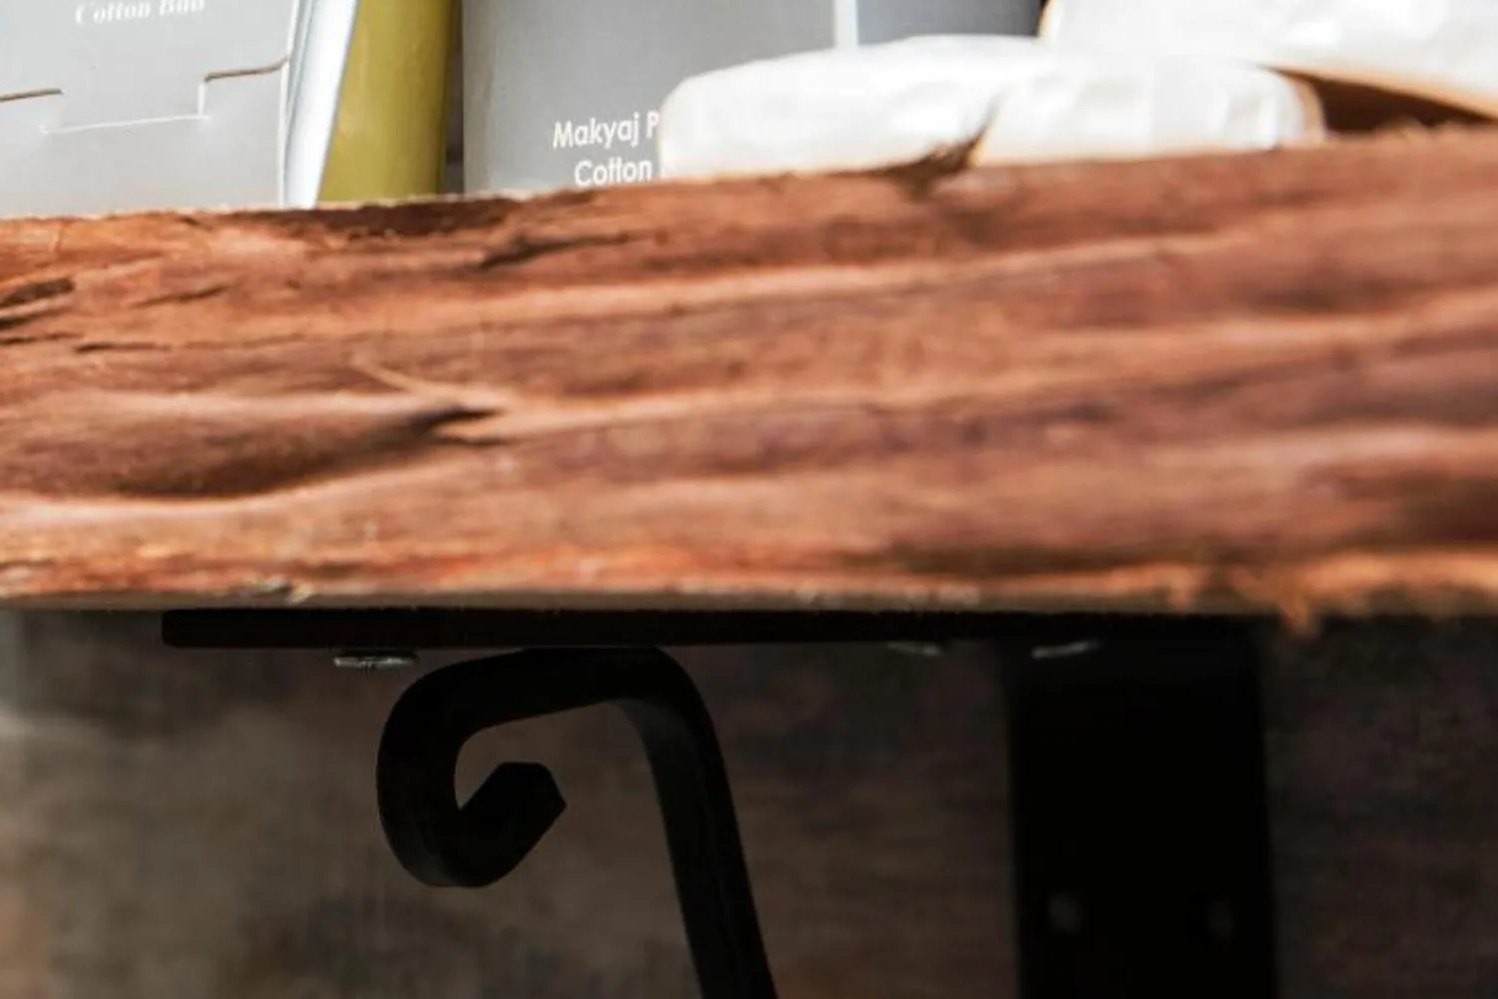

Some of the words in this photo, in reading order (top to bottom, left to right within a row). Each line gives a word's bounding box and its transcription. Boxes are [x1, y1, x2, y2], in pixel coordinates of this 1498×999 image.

[74, 1, 152, 25] Cotton
[552, 112, 640, 150] Makyaj
[574, 156, 653, 188] Cotton
